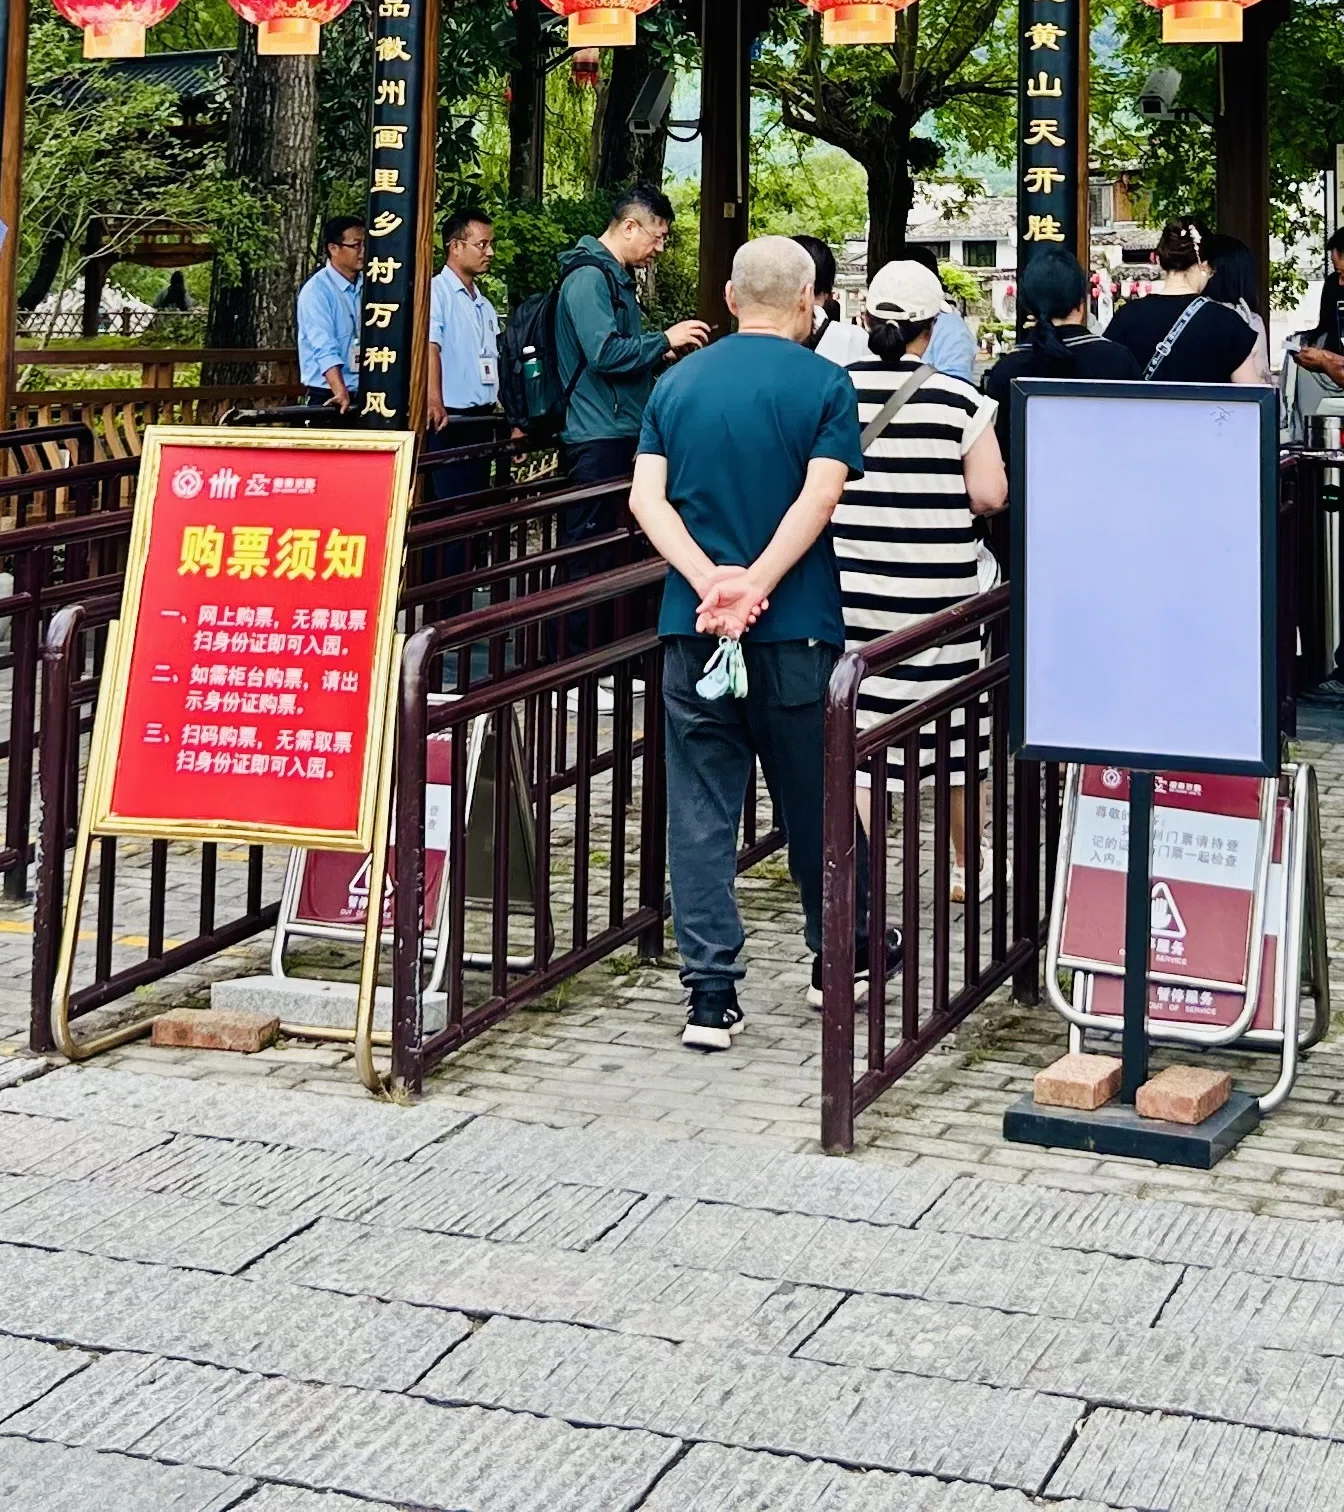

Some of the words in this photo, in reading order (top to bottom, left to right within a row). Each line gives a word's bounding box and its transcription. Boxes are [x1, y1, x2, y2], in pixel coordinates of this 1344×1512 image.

[177, 524, 368, 580] 购票须知
[193, 632, 349, 656] 扫身份证即可入园。
[185, 690, 305, 715] 示身份证购票。
[175, 750, 335, 780] 扫身份证即可入园。
